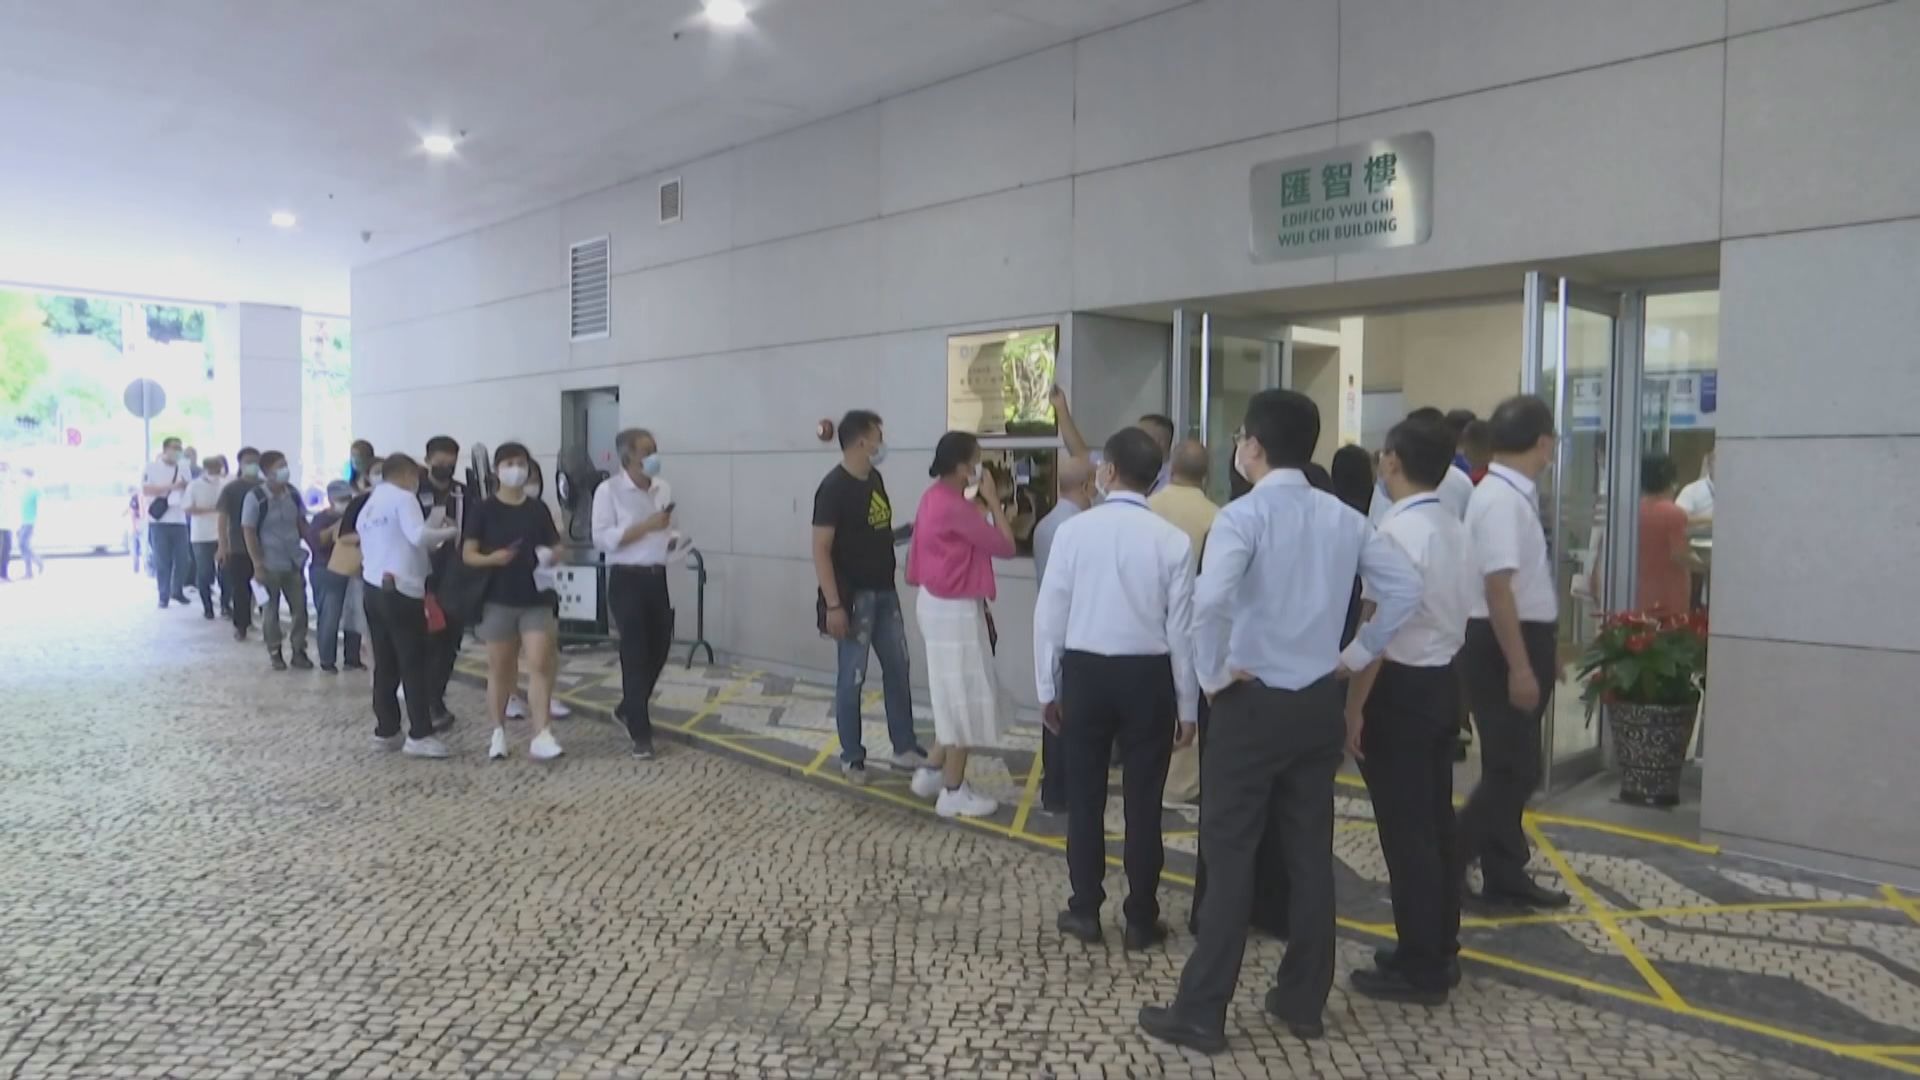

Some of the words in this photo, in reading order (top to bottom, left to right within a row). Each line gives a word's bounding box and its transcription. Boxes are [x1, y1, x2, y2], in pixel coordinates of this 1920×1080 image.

[1281, 153, 1397, 208] 匯智樓
[1339, 202, 1367, 217] WUI
[1371, 198, 1394, 213] CHI
[1278, 231, 1305, 247] WUI
[1309, 227, 1330, 243] CHI
[1334, 218, 1397, 239] BUILDING
